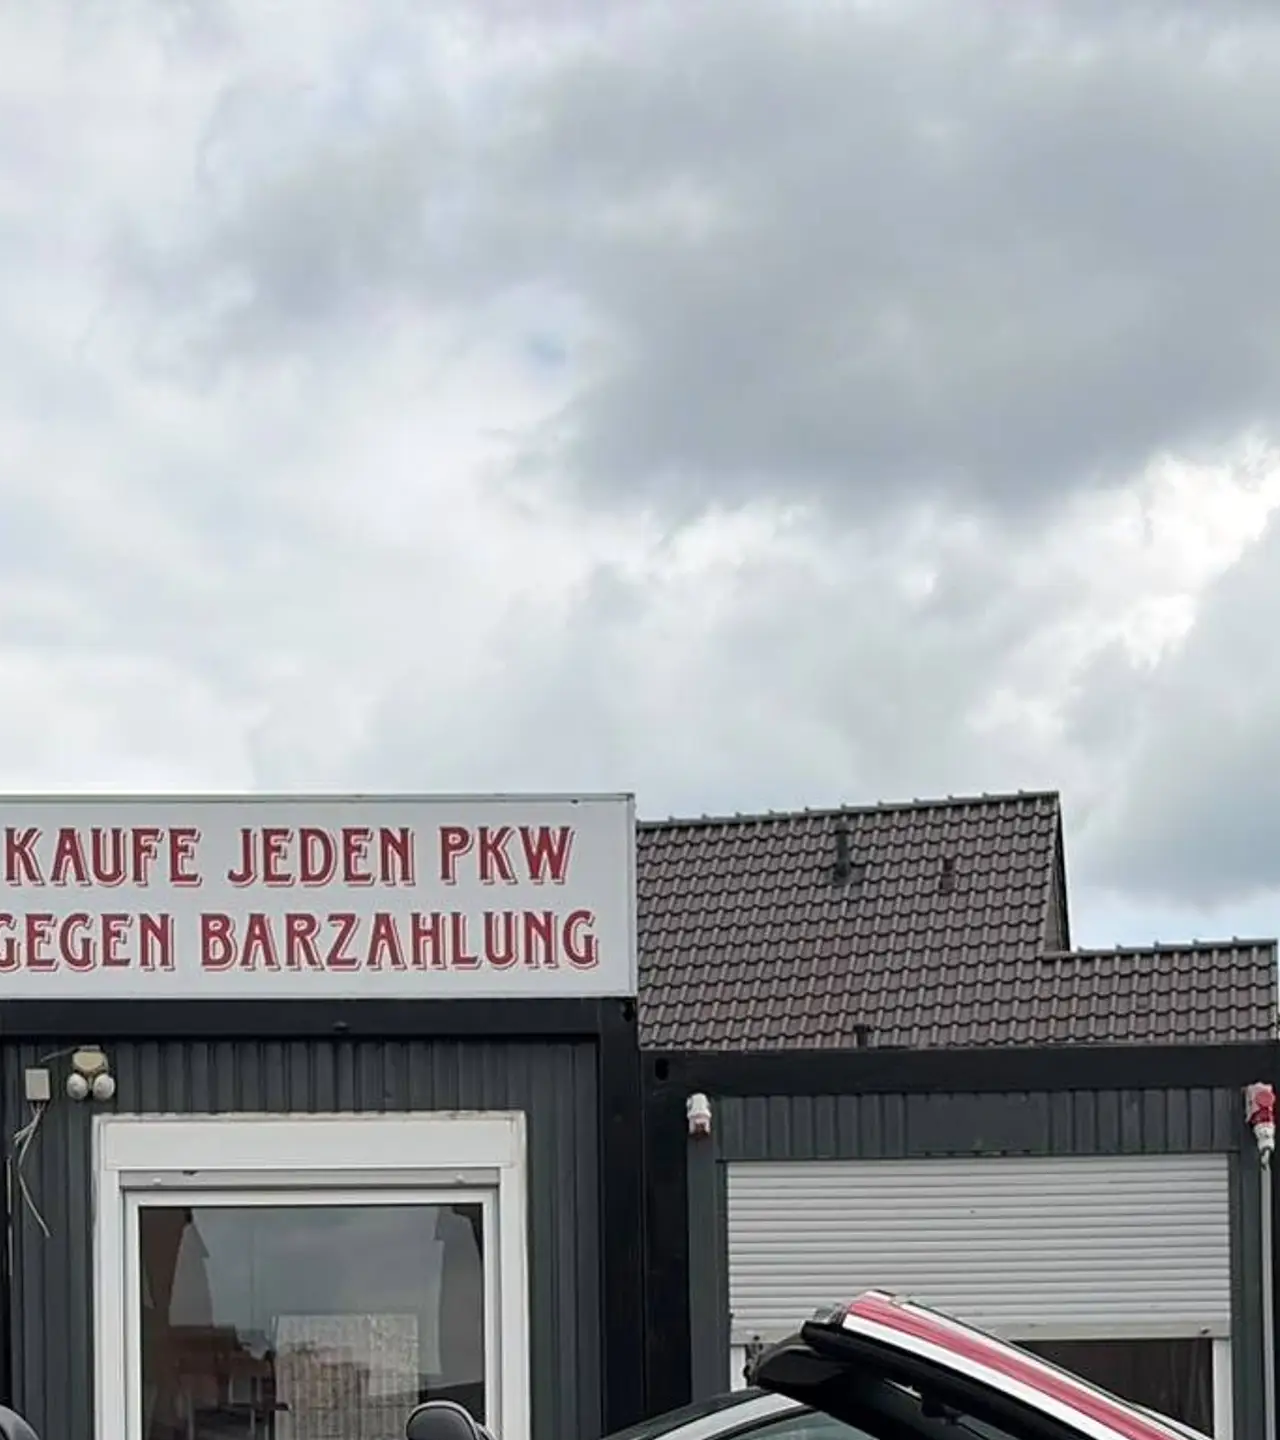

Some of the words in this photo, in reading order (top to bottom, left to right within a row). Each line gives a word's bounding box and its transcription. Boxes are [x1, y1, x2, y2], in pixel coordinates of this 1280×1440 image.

[4, 826, 202, 887] KAUFE
[227, 826, 414, 887] JEDEN
[439, 825, 577, 884] PKW
[198, 908, 598, 973] BARZAHLUNG
